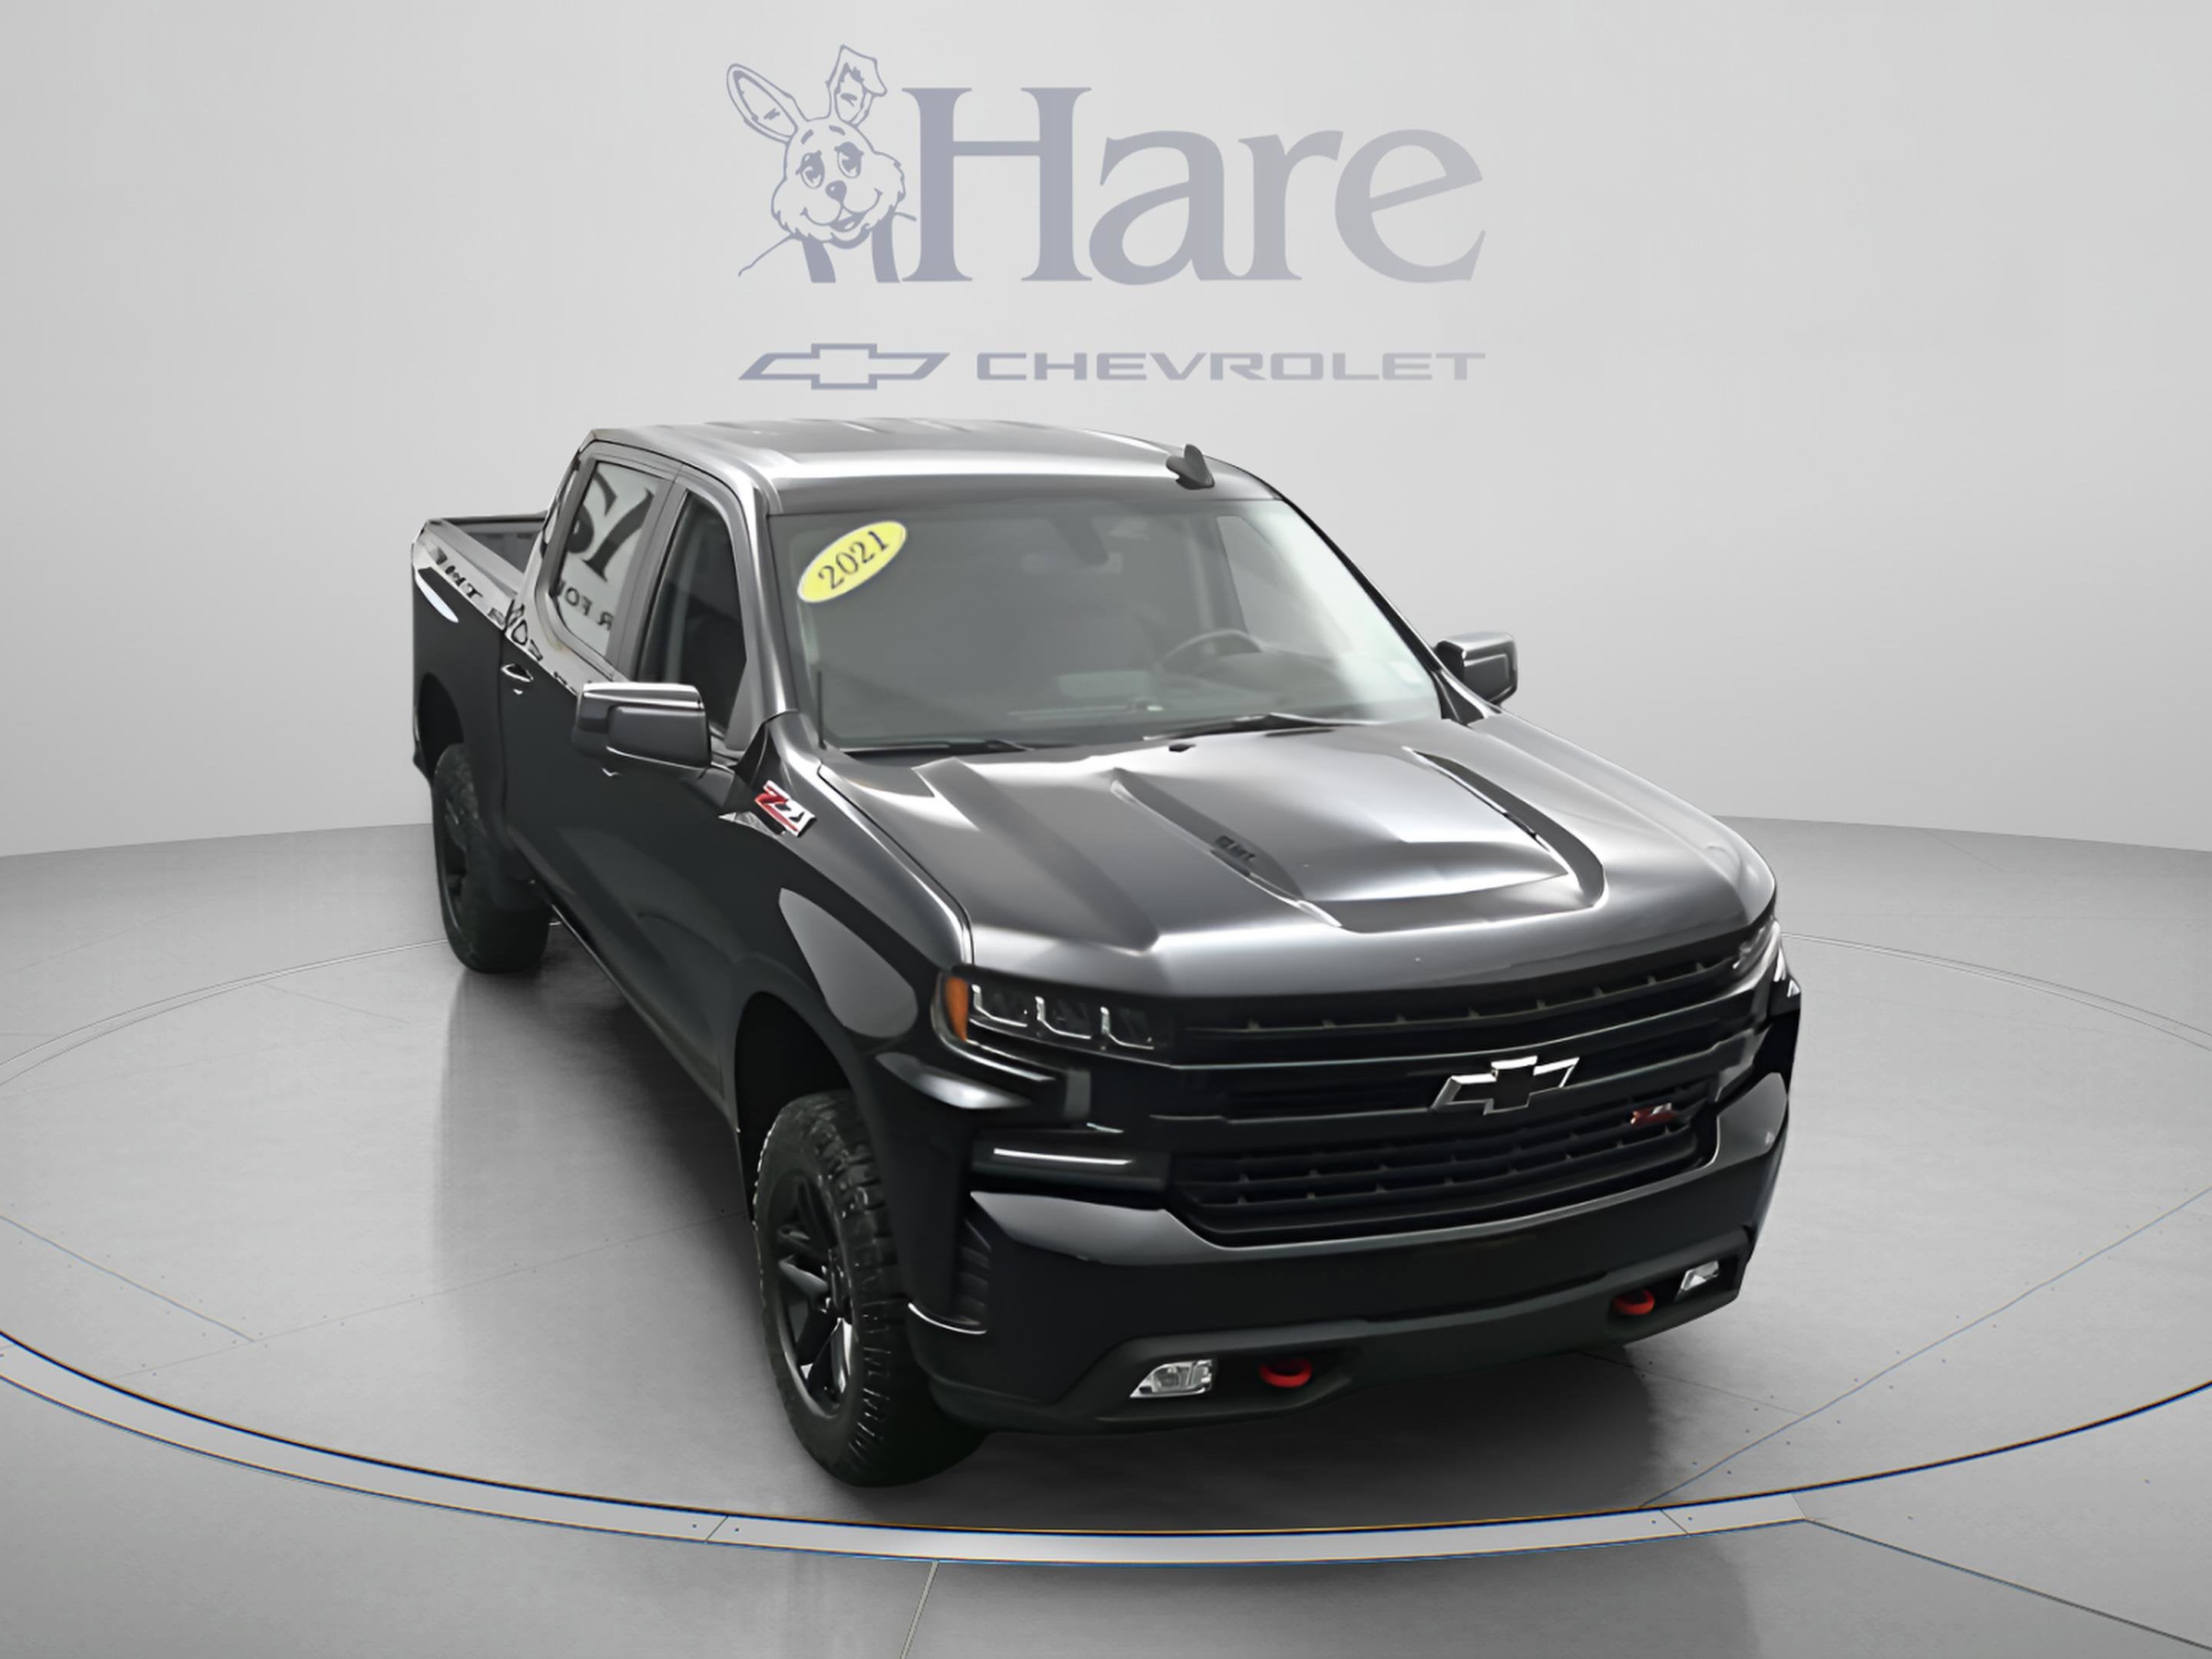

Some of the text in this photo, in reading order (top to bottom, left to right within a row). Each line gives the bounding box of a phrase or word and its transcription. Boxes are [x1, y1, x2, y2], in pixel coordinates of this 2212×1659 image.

[902, 88, 1485, 285] Hare
[977, 353, 1485, 380] CHEVROLET
[818, 530, 888, 590] 2021
